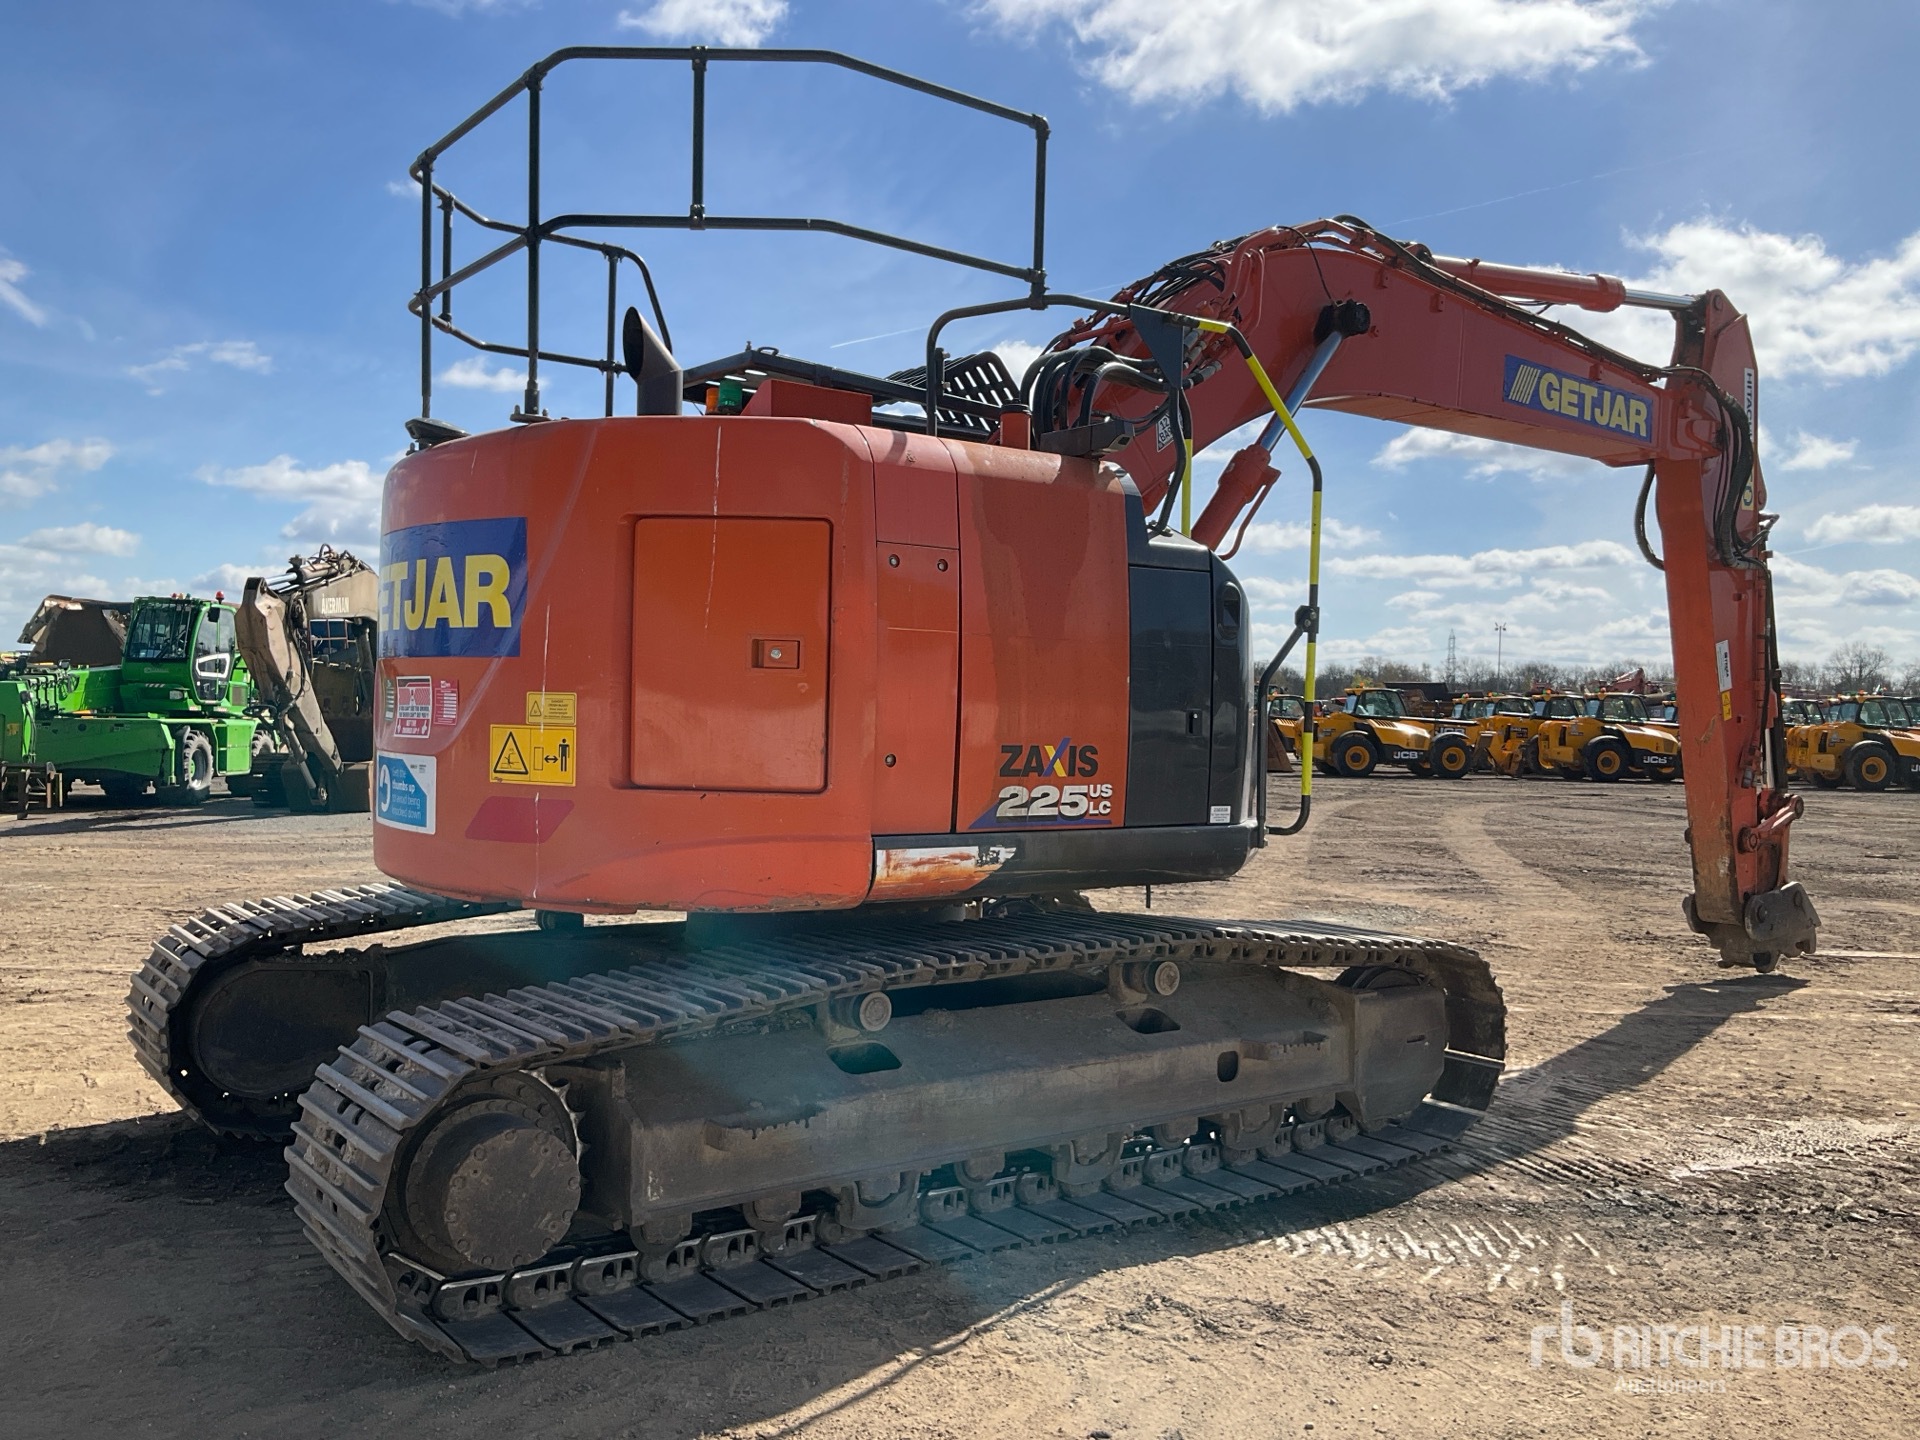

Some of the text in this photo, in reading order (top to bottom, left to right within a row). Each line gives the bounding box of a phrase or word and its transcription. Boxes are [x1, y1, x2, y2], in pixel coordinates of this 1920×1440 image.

[1539, 372, 1648, 437] GETJAR
[321, 593, 349, 614] ÅKERMAN
[379, 554, 512, 632] ETJAR
[999, 737, 1098, 777] ZAXIS
[1393, 751, 1418, 759] JCB
[996, 784, 1113, 818] 225 US
[1089, 801, 1111, 815] LC
